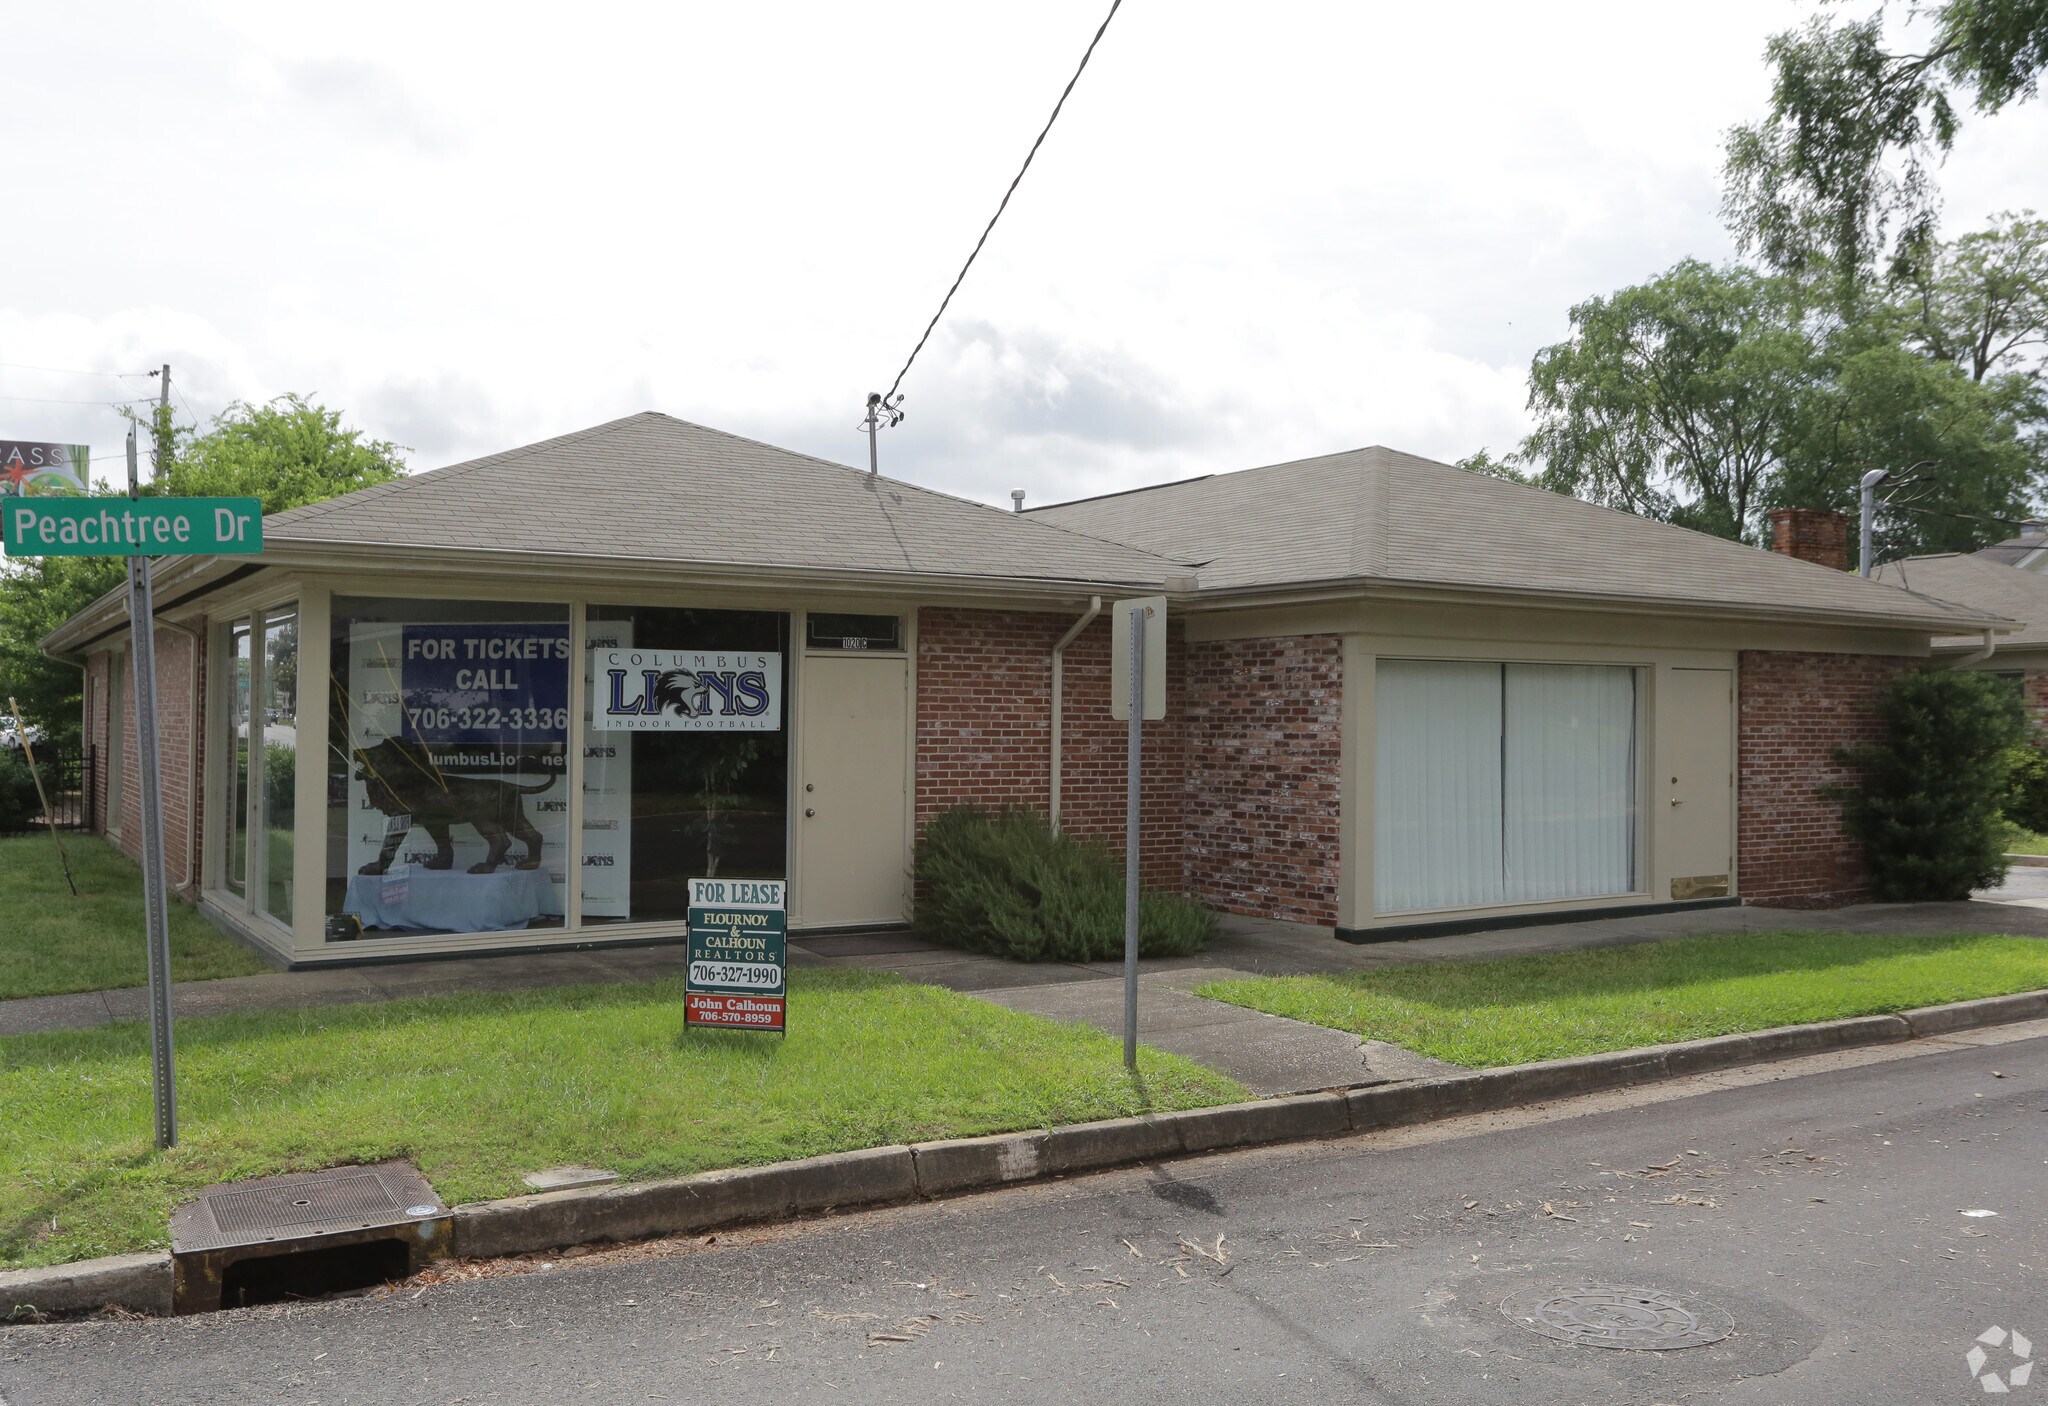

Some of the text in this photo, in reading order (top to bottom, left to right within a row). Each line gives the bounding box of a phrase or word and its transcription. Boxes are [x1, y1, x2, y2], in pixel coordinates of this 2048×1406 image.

[0, 446, 63, 466] ASS
[15, 508, 250, 544] Peachtree Dr
[408, 638, 569, 659] FOR TICKETS
[608, 653, 767, 668] COLUMBUS
[455, 669, 519, 690] CALL
[408, 708, 568, 730] 706-322-3336
[606, 720, 671, 728] INDOOR
[695, 882, 780, 905] FOR LEASE
[703, 913, 769, 926] FLOURNOY
[730, 925, 741, 938] &
[705, 936, 766, 950] CALHOUN
[694, 949, 776, 961] REALTORS
[693, 965, 778, 984] 706-327-1990
[690, 998, 781, 1012] John Calhoun
[699, 1011, 772, 1023] 706-570-8959
